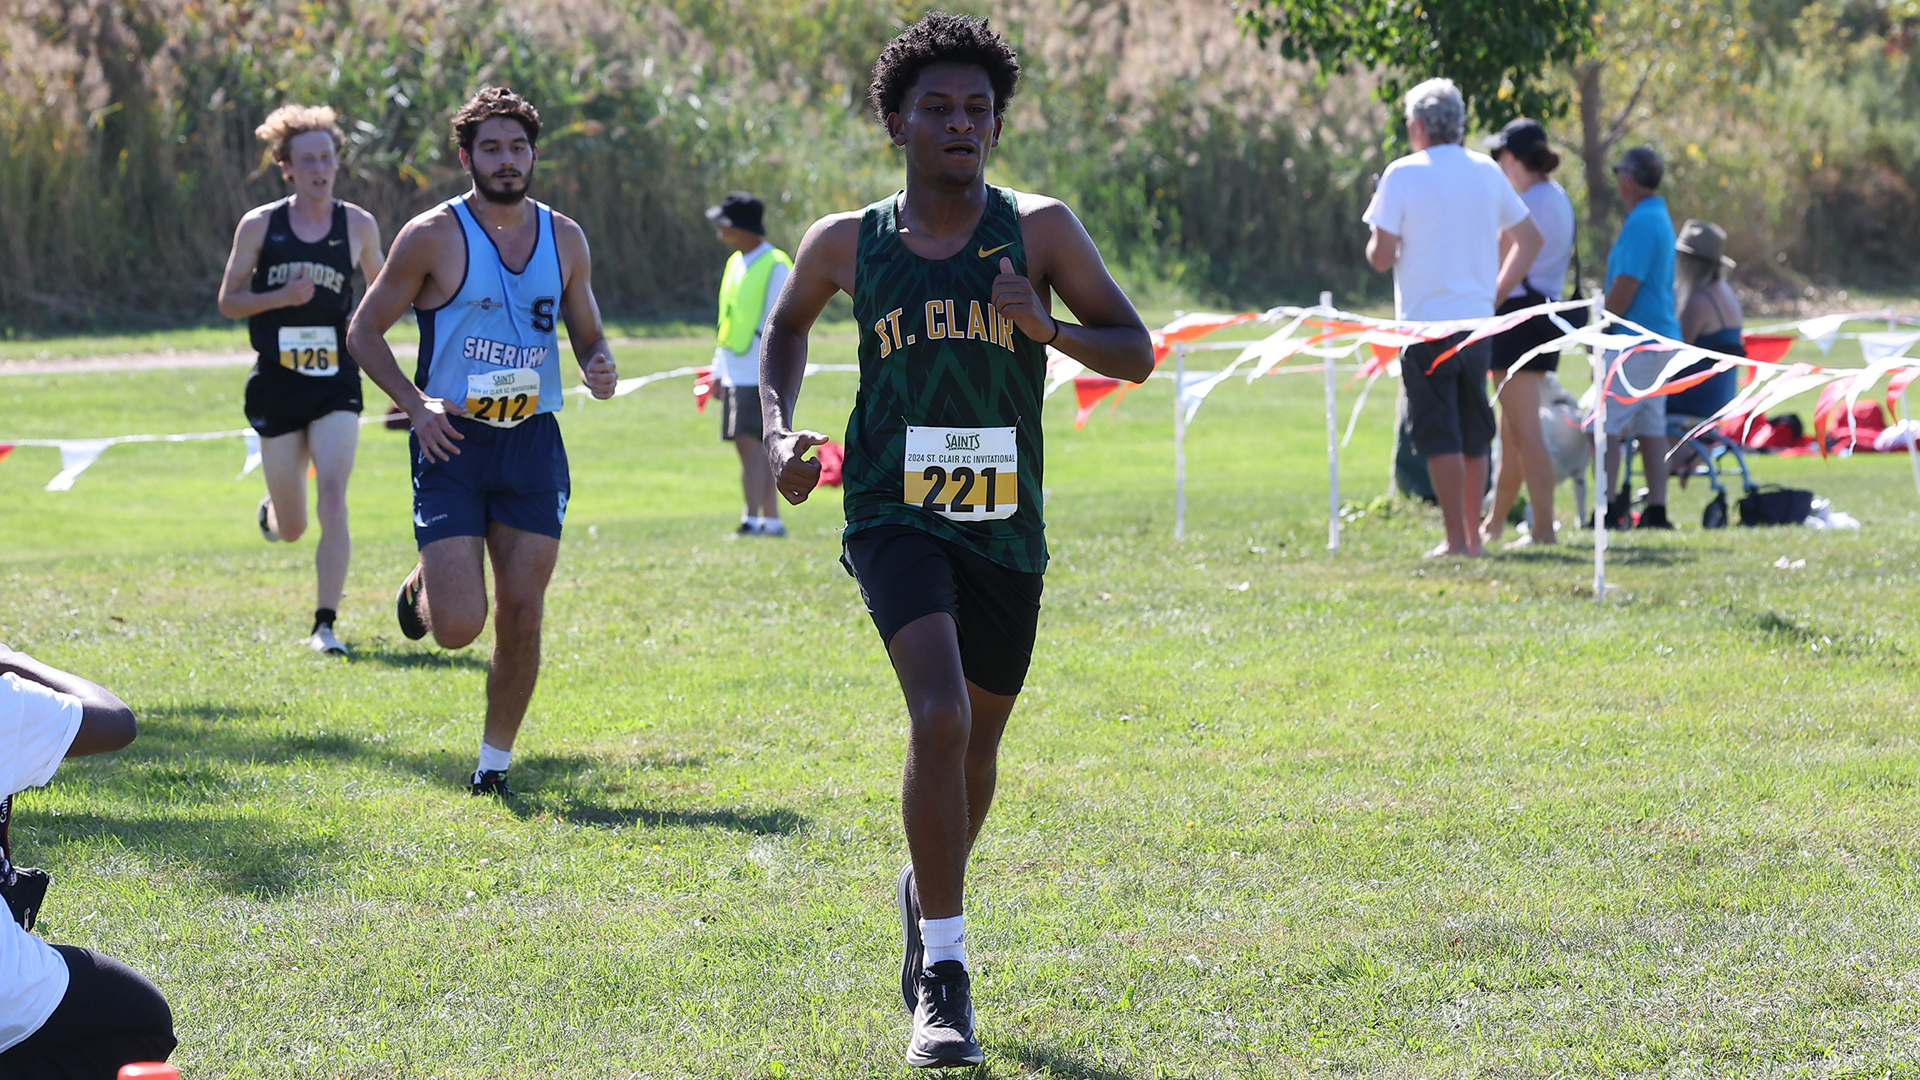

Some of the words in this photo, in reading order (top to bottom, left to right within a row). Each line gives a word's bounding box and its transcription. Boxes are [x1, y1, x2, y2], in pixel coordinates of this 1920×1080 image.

[531, 296, 556, 335] S
[874, 307, 917, 359] ST.
[925, 299, 1015, 353] CLAIR
[290, 348, 329, 370] 126
[492, 373, 516, 384] SAINTS
[474, 392, 528, 422] 212
[945, 433, 981, 449] SAINTS
[908, 453, 925, 462] 2024
[926, 454, 937, 463] ST.
[939, 454, 960, 463] CLAIR
[962, 455, 972, 464] XC
[973, 454, 1016, 464] INVITATIONAL
[922, 466, 997, 512] 221
